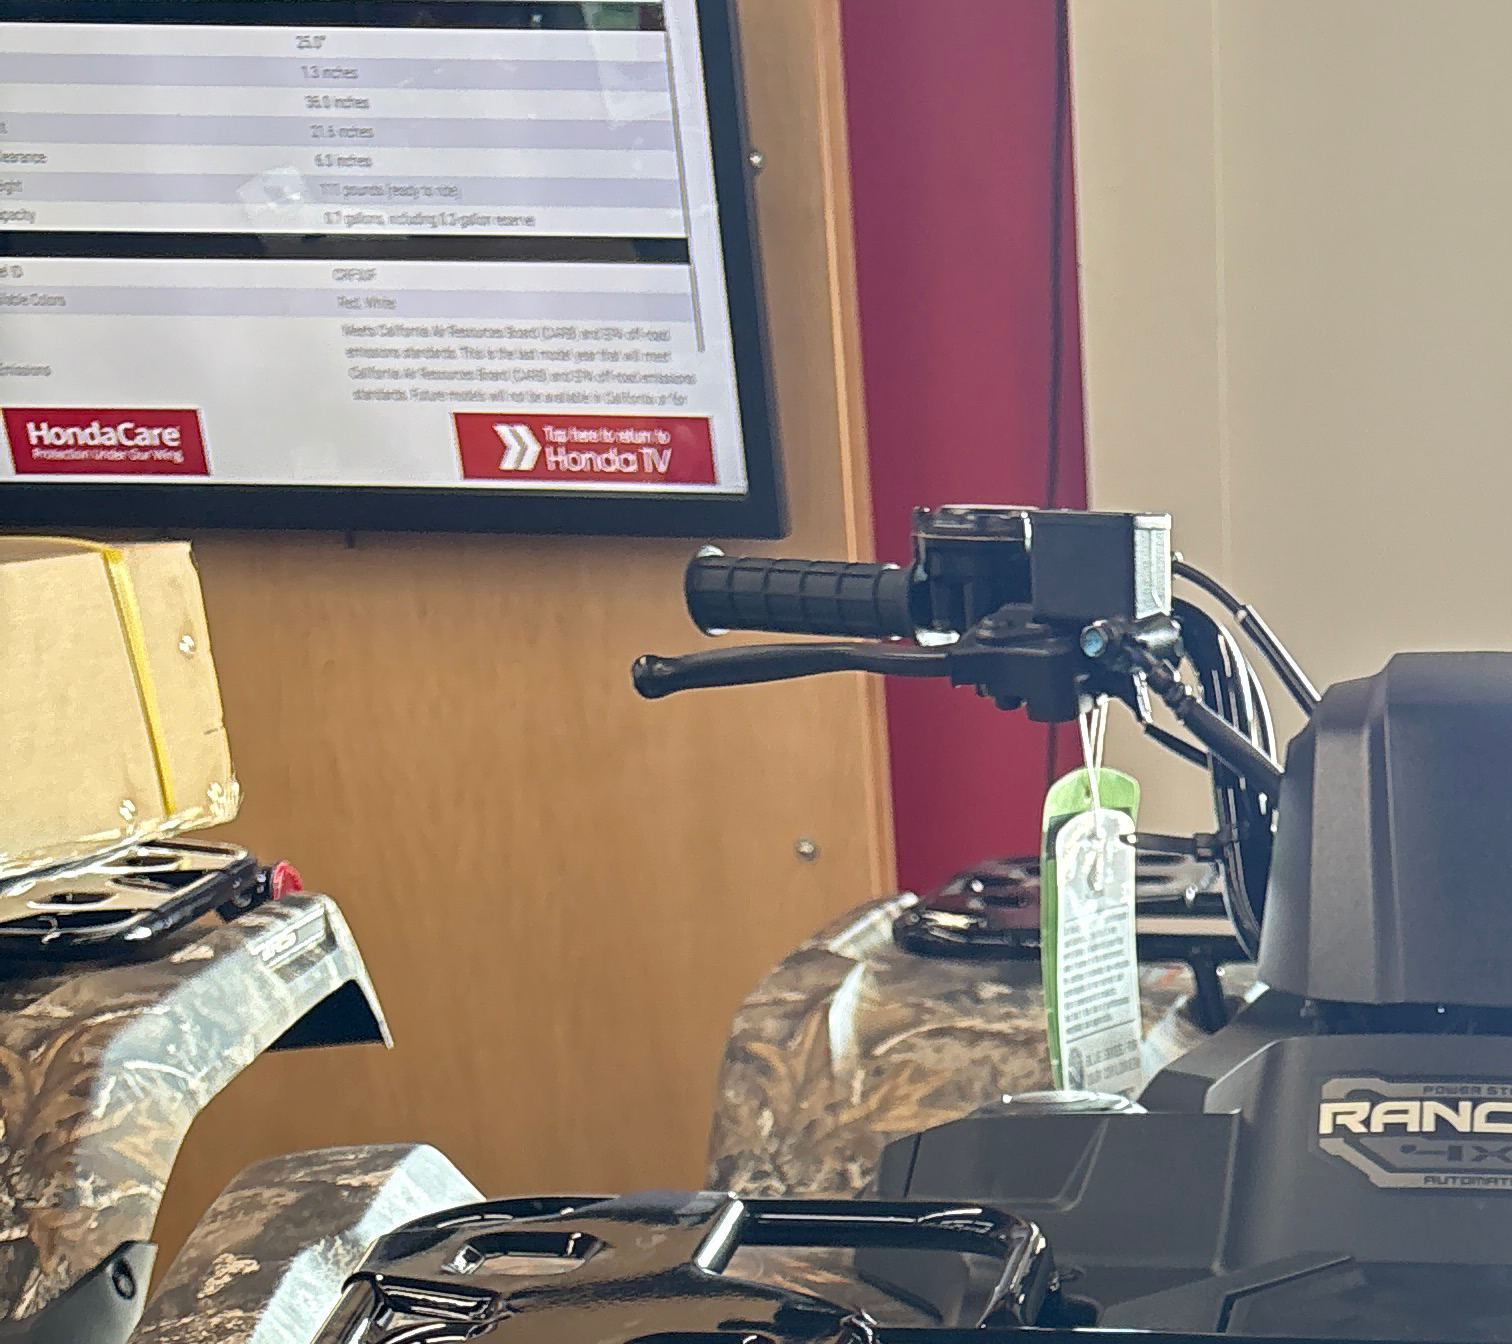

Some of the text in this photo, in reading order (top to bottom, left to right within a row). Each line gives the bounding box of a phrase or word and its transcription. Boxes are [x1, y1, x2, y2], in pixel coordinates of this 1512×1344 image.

[26, 419, 181, 447] HondaCare
[544, 445, 673, 474] Honda TV
[1422, 1085, 1484, 1098] POWER
